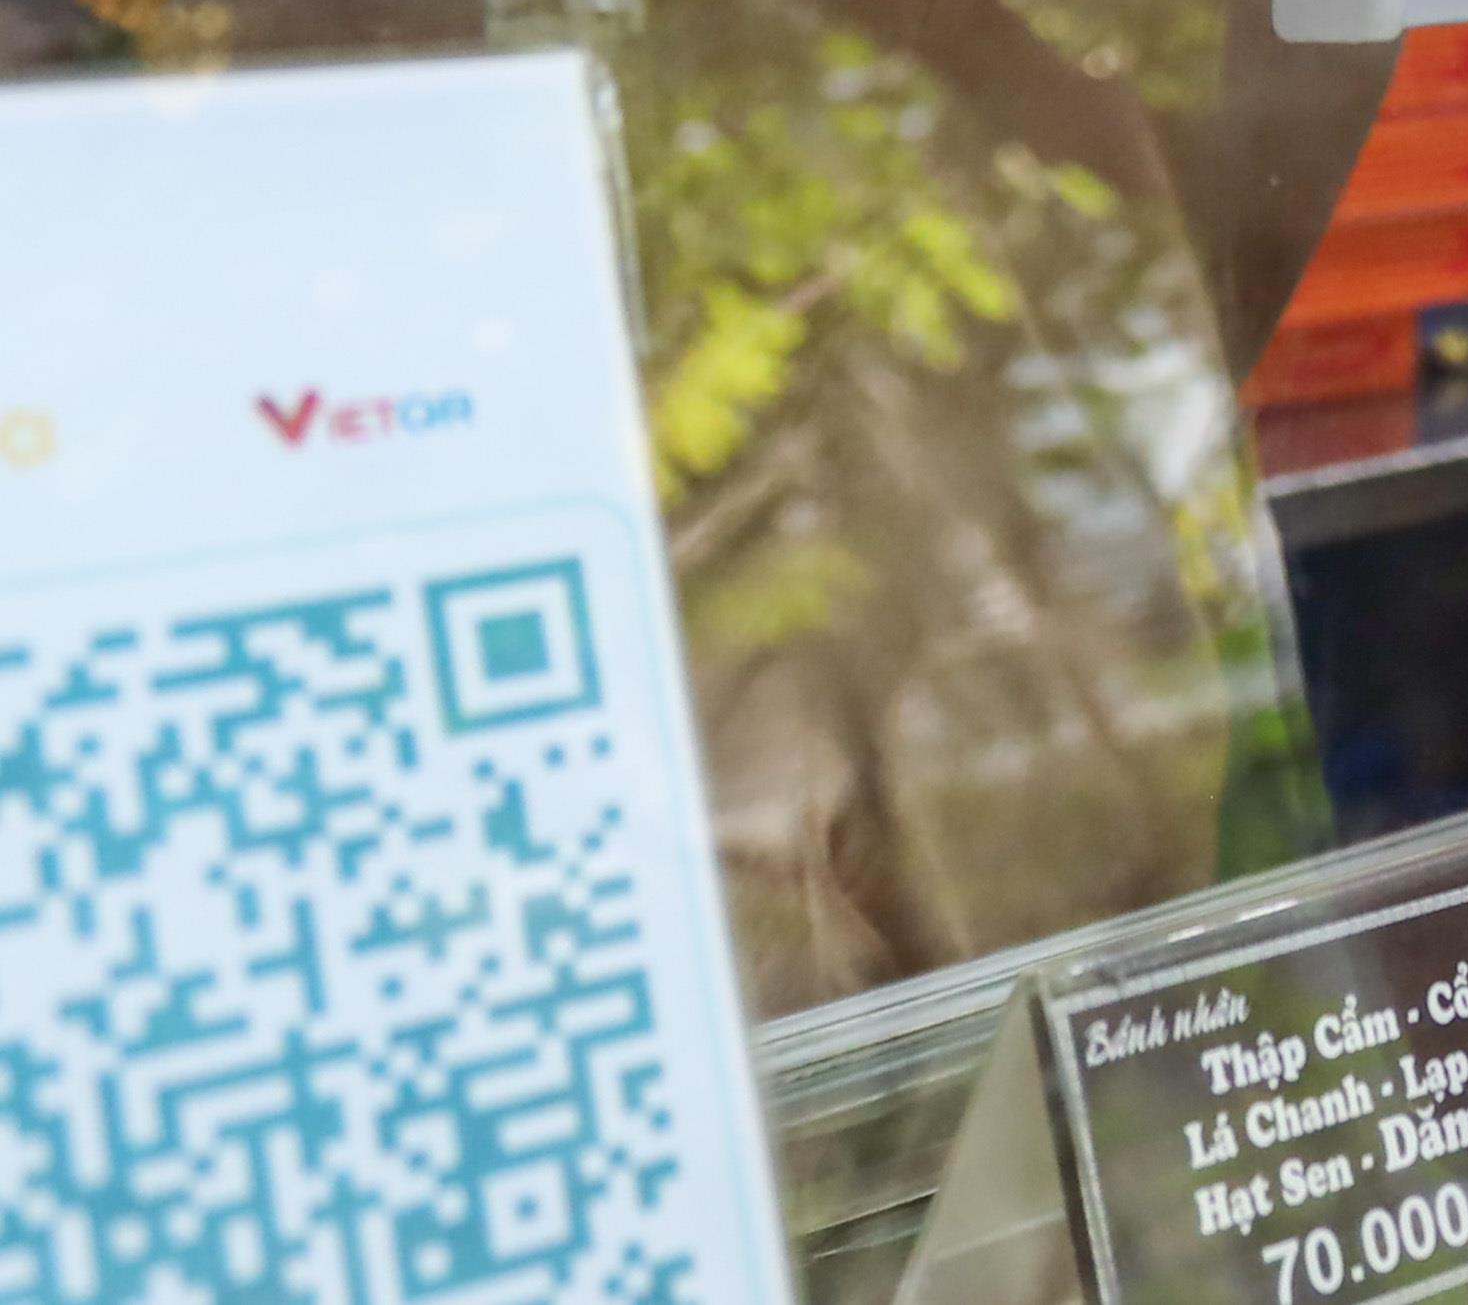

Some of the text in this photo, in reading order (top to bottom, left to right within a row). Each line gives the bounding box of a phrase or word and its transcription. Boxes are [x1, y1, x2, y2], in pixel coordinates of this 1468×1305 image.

[1084, 987, 1250, 1068] Bánh nhân
[1201, 1031, 1307, 1095] Thập
[1313, 992, 1401, 1060] Cẩm
[1183, 1110, 1239, 1170] Lá
[1245, 1074, 1375, 1148] Chanh
[1193, 1172, 1274, 1237] Hạt
[1279, 1156, 1355, 1207] Sen
